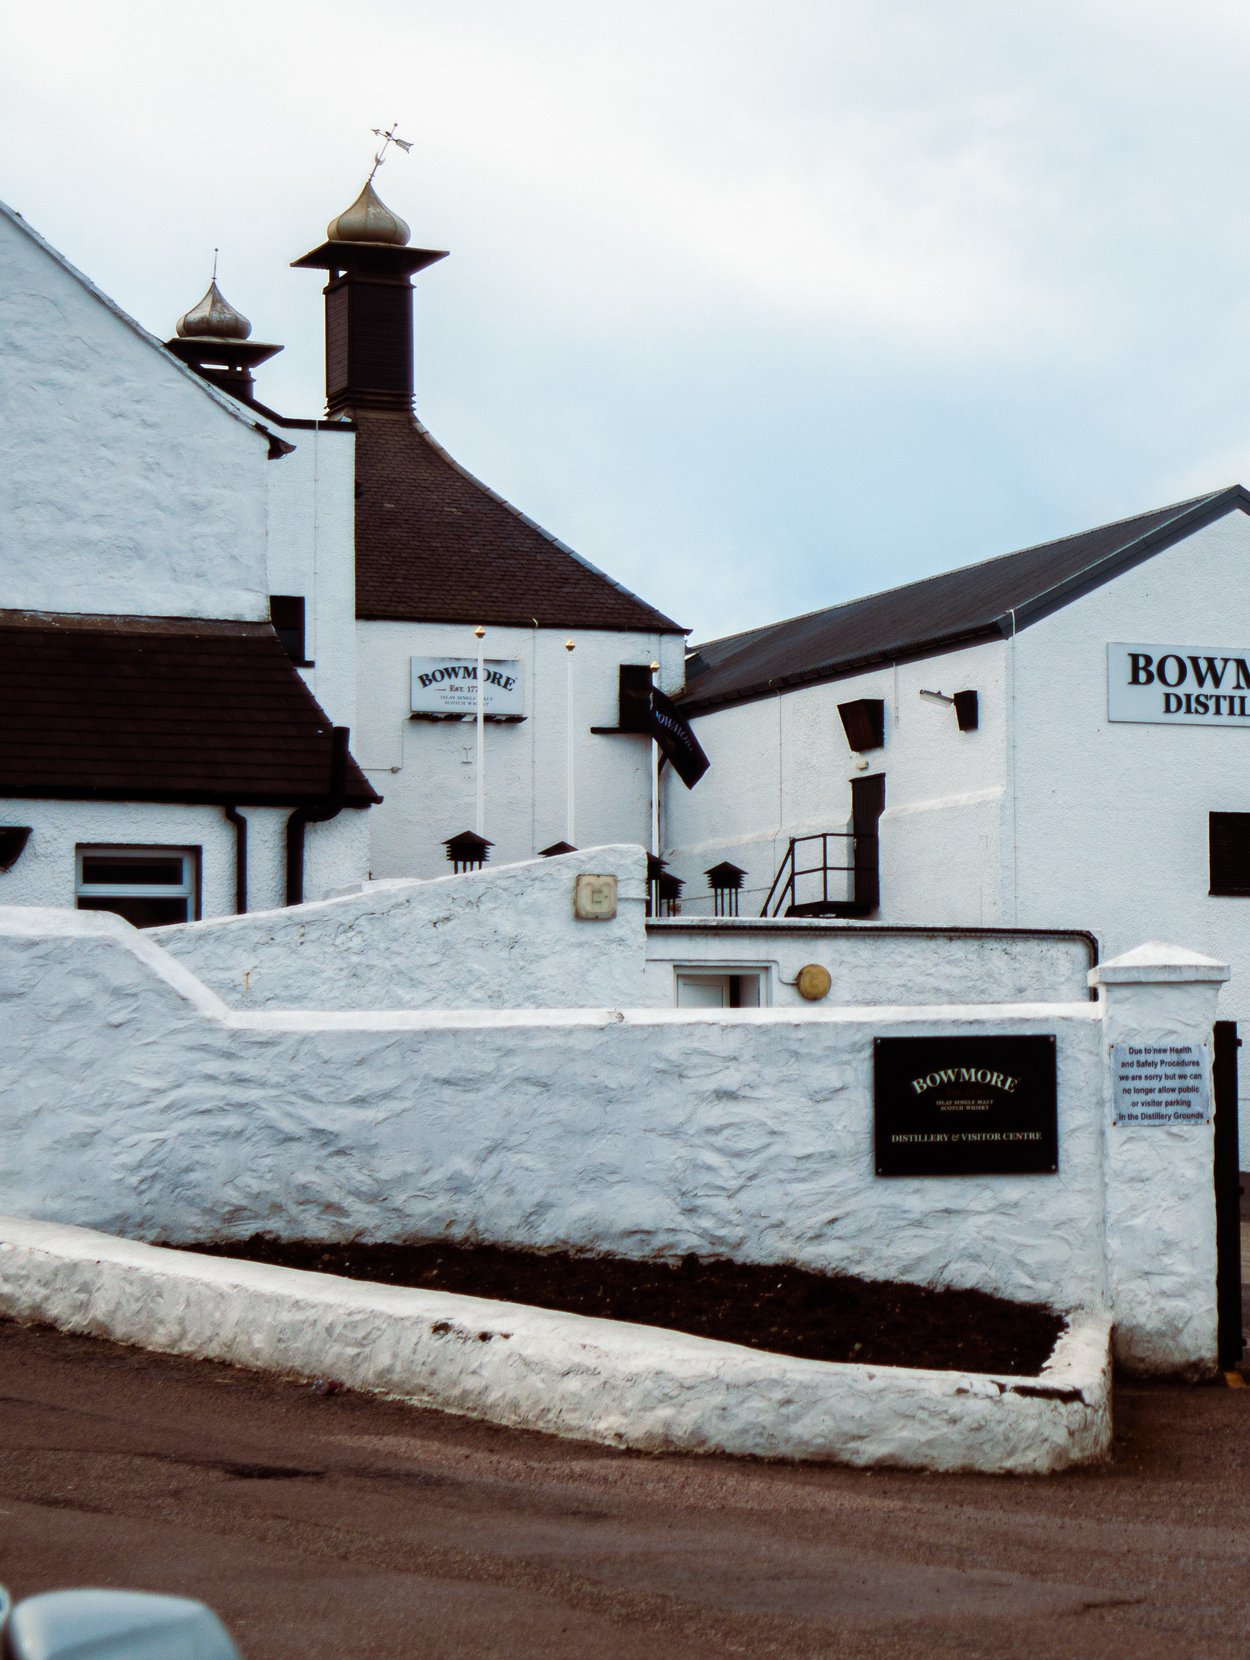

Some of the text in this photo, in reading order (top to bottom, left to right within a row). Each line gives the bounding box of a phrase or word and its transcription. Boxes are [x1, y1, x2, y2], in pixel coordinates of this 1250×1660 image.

[1128, 1047, 1143, 1055] Due
[1144, 1047, 1152, 1055] to
[1169, 1046, 1192, 1054] Health
[1121, 1059, 1200, 1069] and Safety Procedures
[911, 1068, 1018, 1094] BOWMORE
[1144, 1074, 1163, 1082] sorry
[1133, 1086, 1156, 1096] longer
[1178, 1085, 1199, 1095] public
[1141, 1099, 1163, 1107] visitor
[1164, 1099, 1192, 1108] parking
[1140, 1112, 1172, 1121] Distillery
[1173, 1112, 1204, 1120] Grounds
[891, 1132, 1042, 1143] DISTILLERY & VISITOR CENTRE
